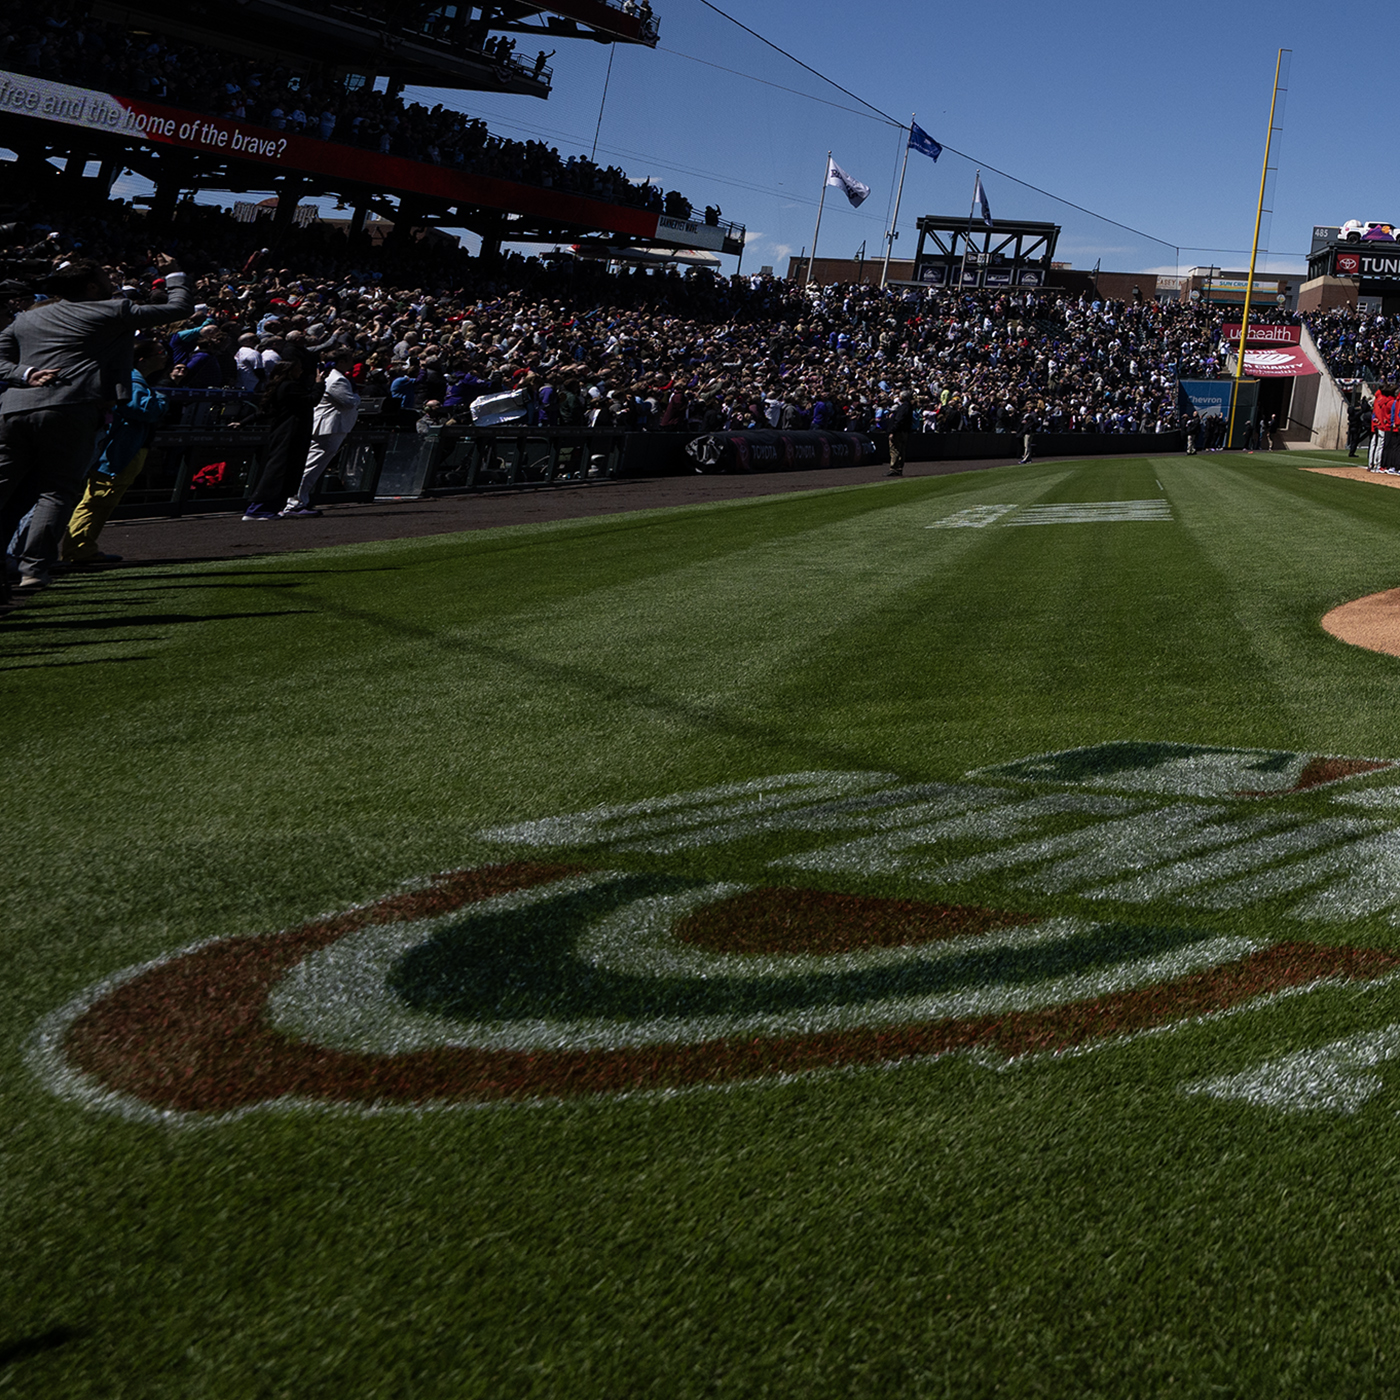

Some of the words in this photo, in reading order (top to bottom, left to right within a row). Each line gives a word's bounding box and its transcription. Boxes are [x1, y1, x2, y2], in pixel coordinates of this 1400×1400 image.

[43, 95, 85, 119] and
[88, 101, 121, 125] the
[124, 107, 176, 136] home
[179, 121, 202, 141] of
[202, 124, 228, 147] the
[231, 130, 287, 159] brave?
[1315, 228, 1328, 237] 485
[751, 445, 777, 459] TOYOTA
